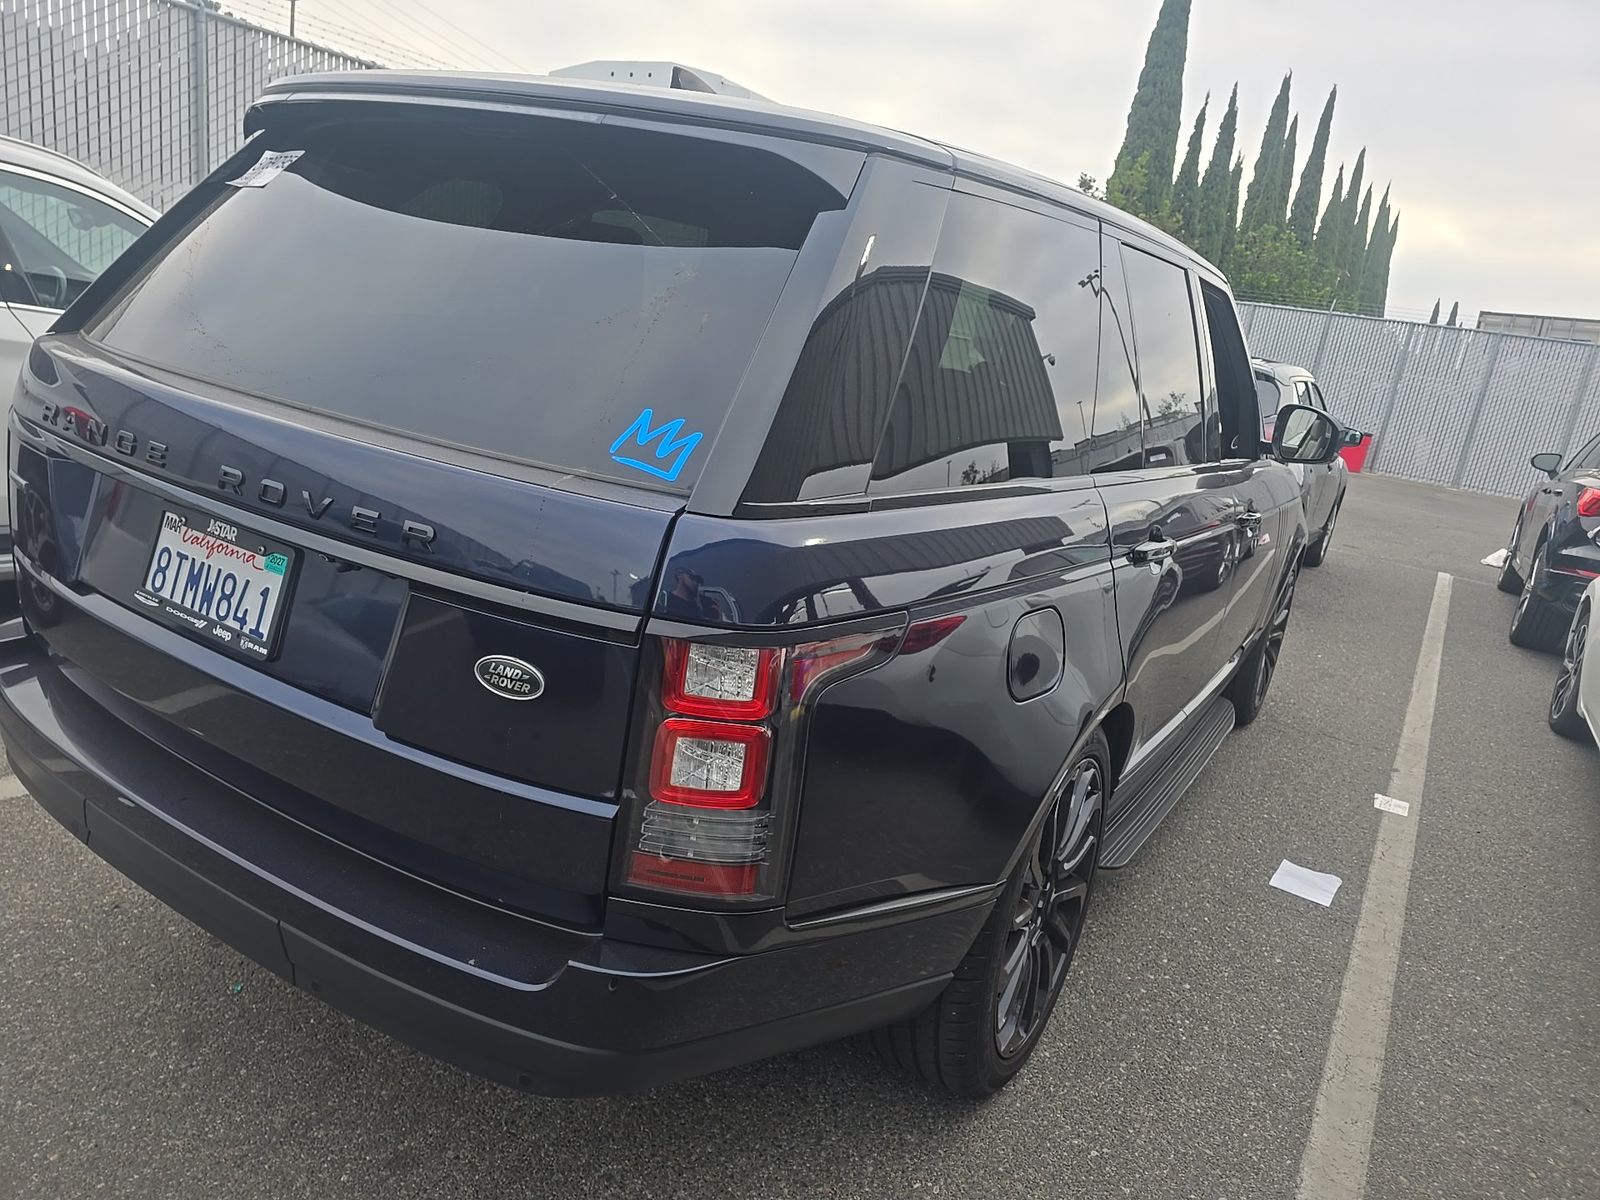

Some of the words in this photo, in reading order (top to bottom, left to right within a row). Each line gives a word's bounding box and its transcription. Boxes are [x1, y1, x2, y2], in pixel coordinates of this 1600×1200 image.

[42, 402, 169, 468] RANGE
[218, 464, 436, 553] ROVER
[182, 528, 264, 571] California
[150, 546, 270, 639] 8TMW841
[212, 624, 232, 642] Jeep
[247, 643, 268, 656] RAM
[488, 662, 522, 680] LAND
[491, 674, 531, 693] ROVER
